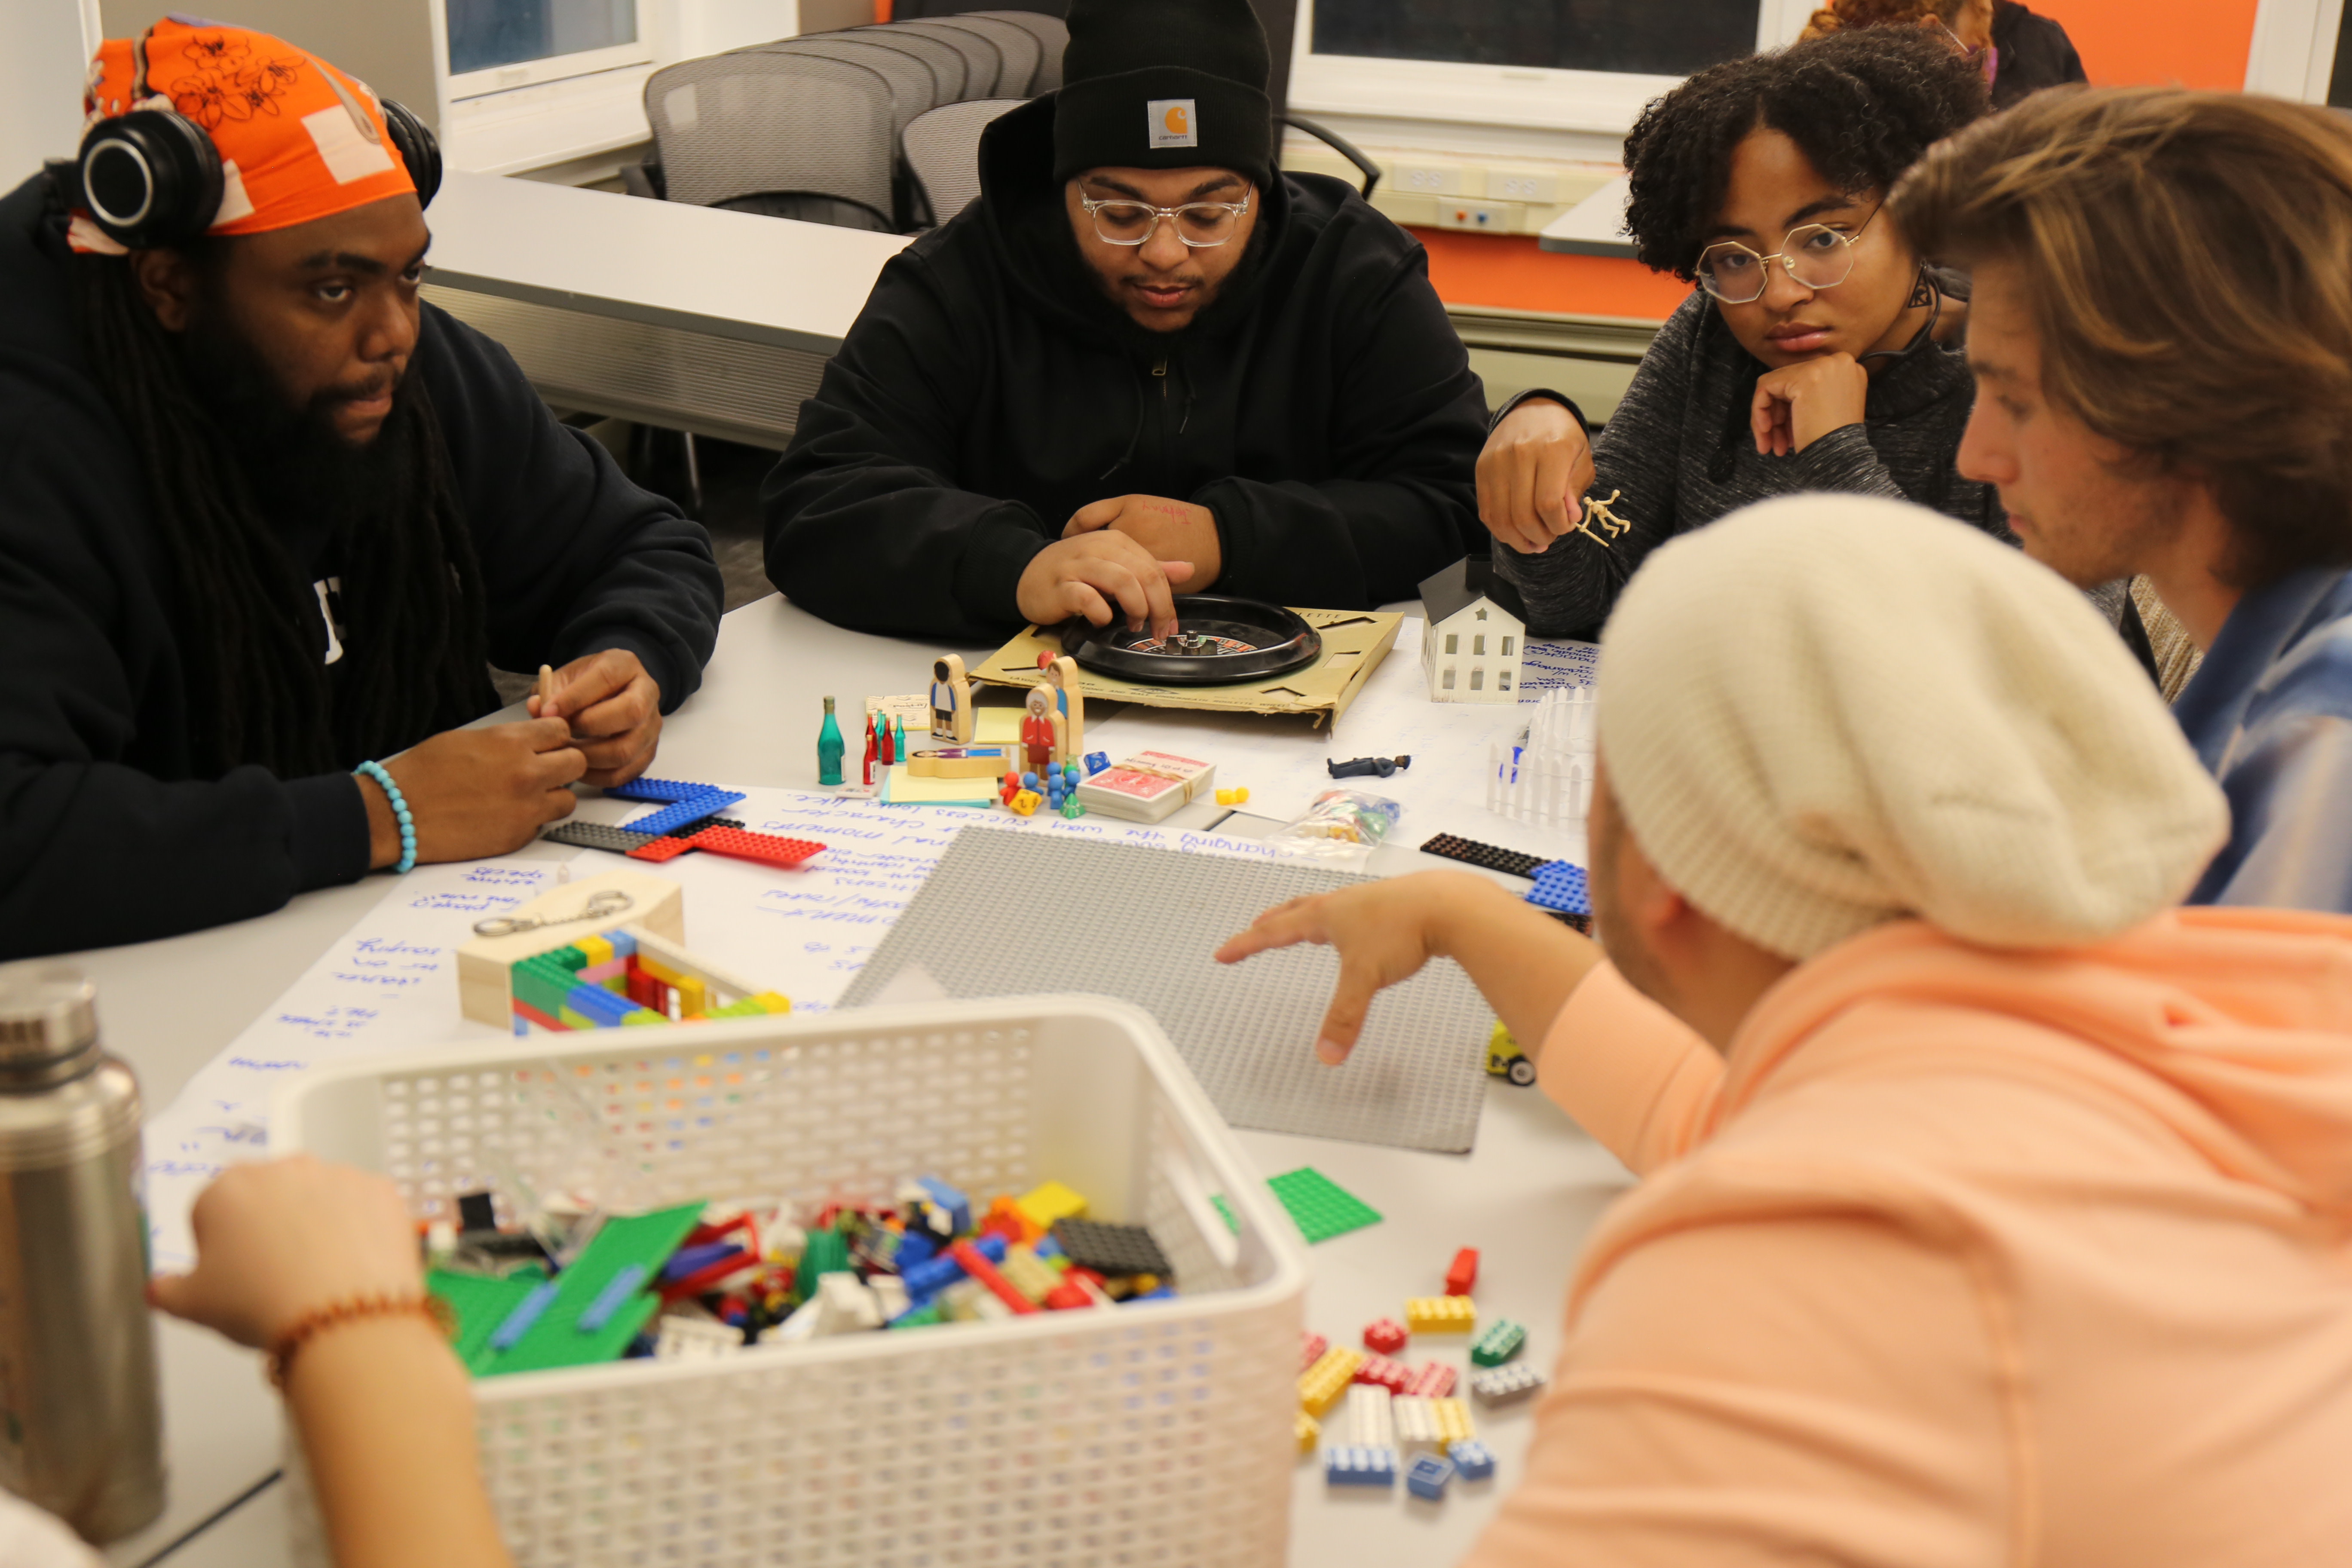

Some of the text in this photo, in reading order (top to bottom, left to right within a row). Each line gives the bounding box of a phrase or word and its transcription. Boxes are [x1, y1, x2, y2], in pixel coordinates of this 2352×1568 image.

[781, 808, 925, 829] character
[935, 808, 1032, 827] success
[761, 820, 884, 840] moments
[1051, 821, 1103, 834] way
[1124, 827, 1165, 840] the
[1180, 831, 1293, 858] changing
